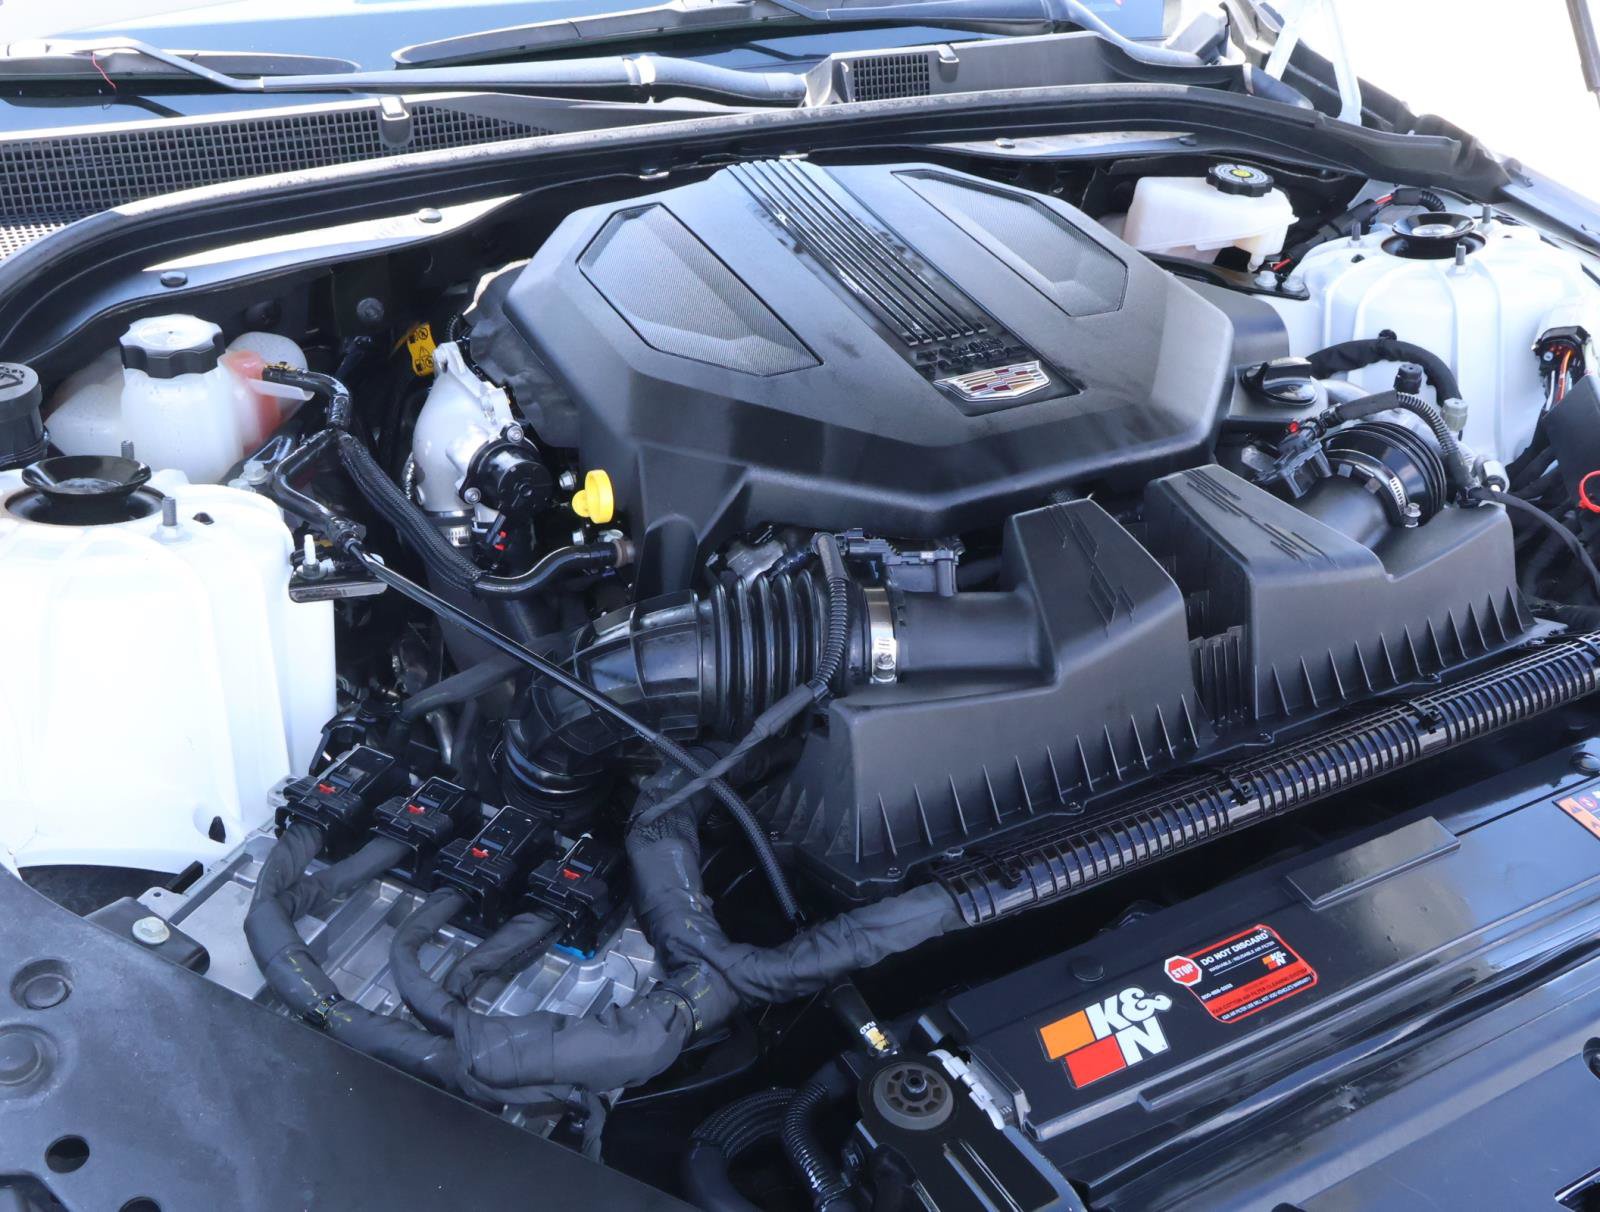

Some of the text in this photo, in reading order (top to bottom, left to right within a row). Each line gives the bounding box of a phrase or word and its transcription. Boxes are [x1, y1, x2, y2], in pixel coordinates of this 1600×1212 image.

[1200, 932, 1268, 966] DO NOT DISCARD
[1172, 963, 1194, 979] STOP
